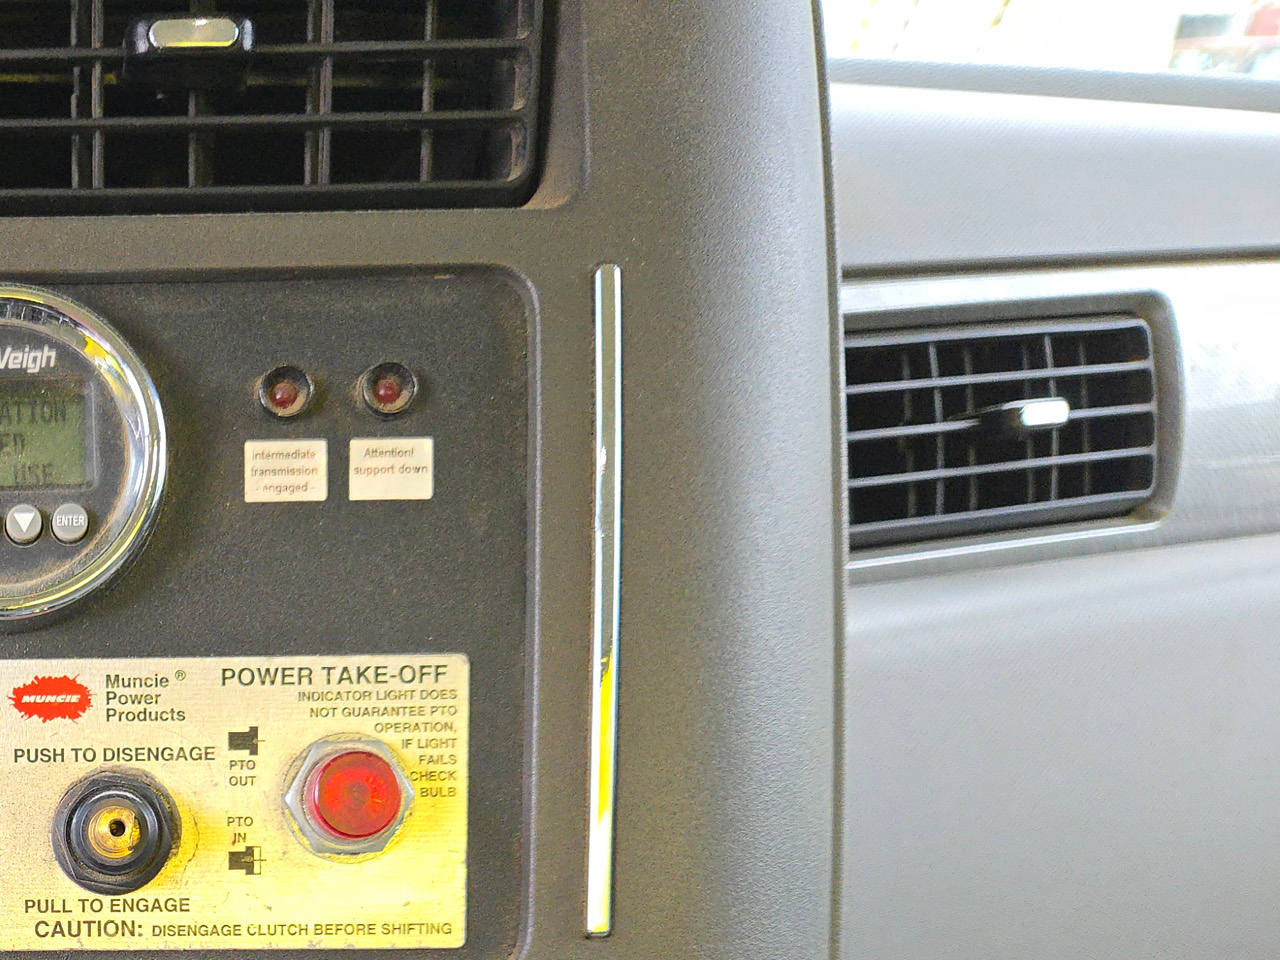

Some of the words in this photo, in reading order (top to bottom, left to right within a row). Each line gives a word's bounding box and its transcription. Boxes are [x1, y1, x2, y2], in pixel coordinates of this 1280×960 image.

[363, 447, 414, 459] Attention!
[250, 466, 318, 477] transmission
[353, 465, 396, 477] support
[397, 463, 429, 475] down
[262, 481, 308, 495] engaged
[56, 514, 85, 526] ENTER
[105, 674, 169, 689] Muncie
[221, 667, 313, 687] POWER
[322, 664, 448, 685] TAKE-OFF
[21, 694, 81, 704] MUNCIE
[105, 692, 161, 706] Power
[298, 691, 372, 702] INDICATOR
[376, 690, 416, 701] LIGHT
[420, 689, 458, 700] DOES
[105, 709, 186, 723] Products
[310, 708, 337, 719] NOT
[342, 706, 426, 718] GUARANTEE
[431, 705, 458, 716] PTO
[402, 738, 414, 750] IF
[417, 738, 457, 749] LIGHT
[14, 748, 65, 763] PUSH
[74, 748, 97, 763] TO
[103, 746, 216, 762] DISENGAGE
[419, 755, 457, 765] FAILS
[229, 760, 256, 770] PTO
[229, 776, 256, 787] OUT
[410, 771, 457, 782] CHECK
[420, 787, 457, 797] BULB
[227, 816, 254, 827] PTO
[233, 832, 247, 843] IN
[24, 898, 72, 913] PULL
[80, 898, 103, 913] TO
[110, 898, 191, 913] ENGAGE
[34, 919, 144, 938] CAUTION:
[152, 925, 242, 937] DISENGAGE
[247, 924, 309, 936] CLUTCH
[314, 924, 376, 936] BEFORE
[381, 922, 452, 935] SHIFTING
